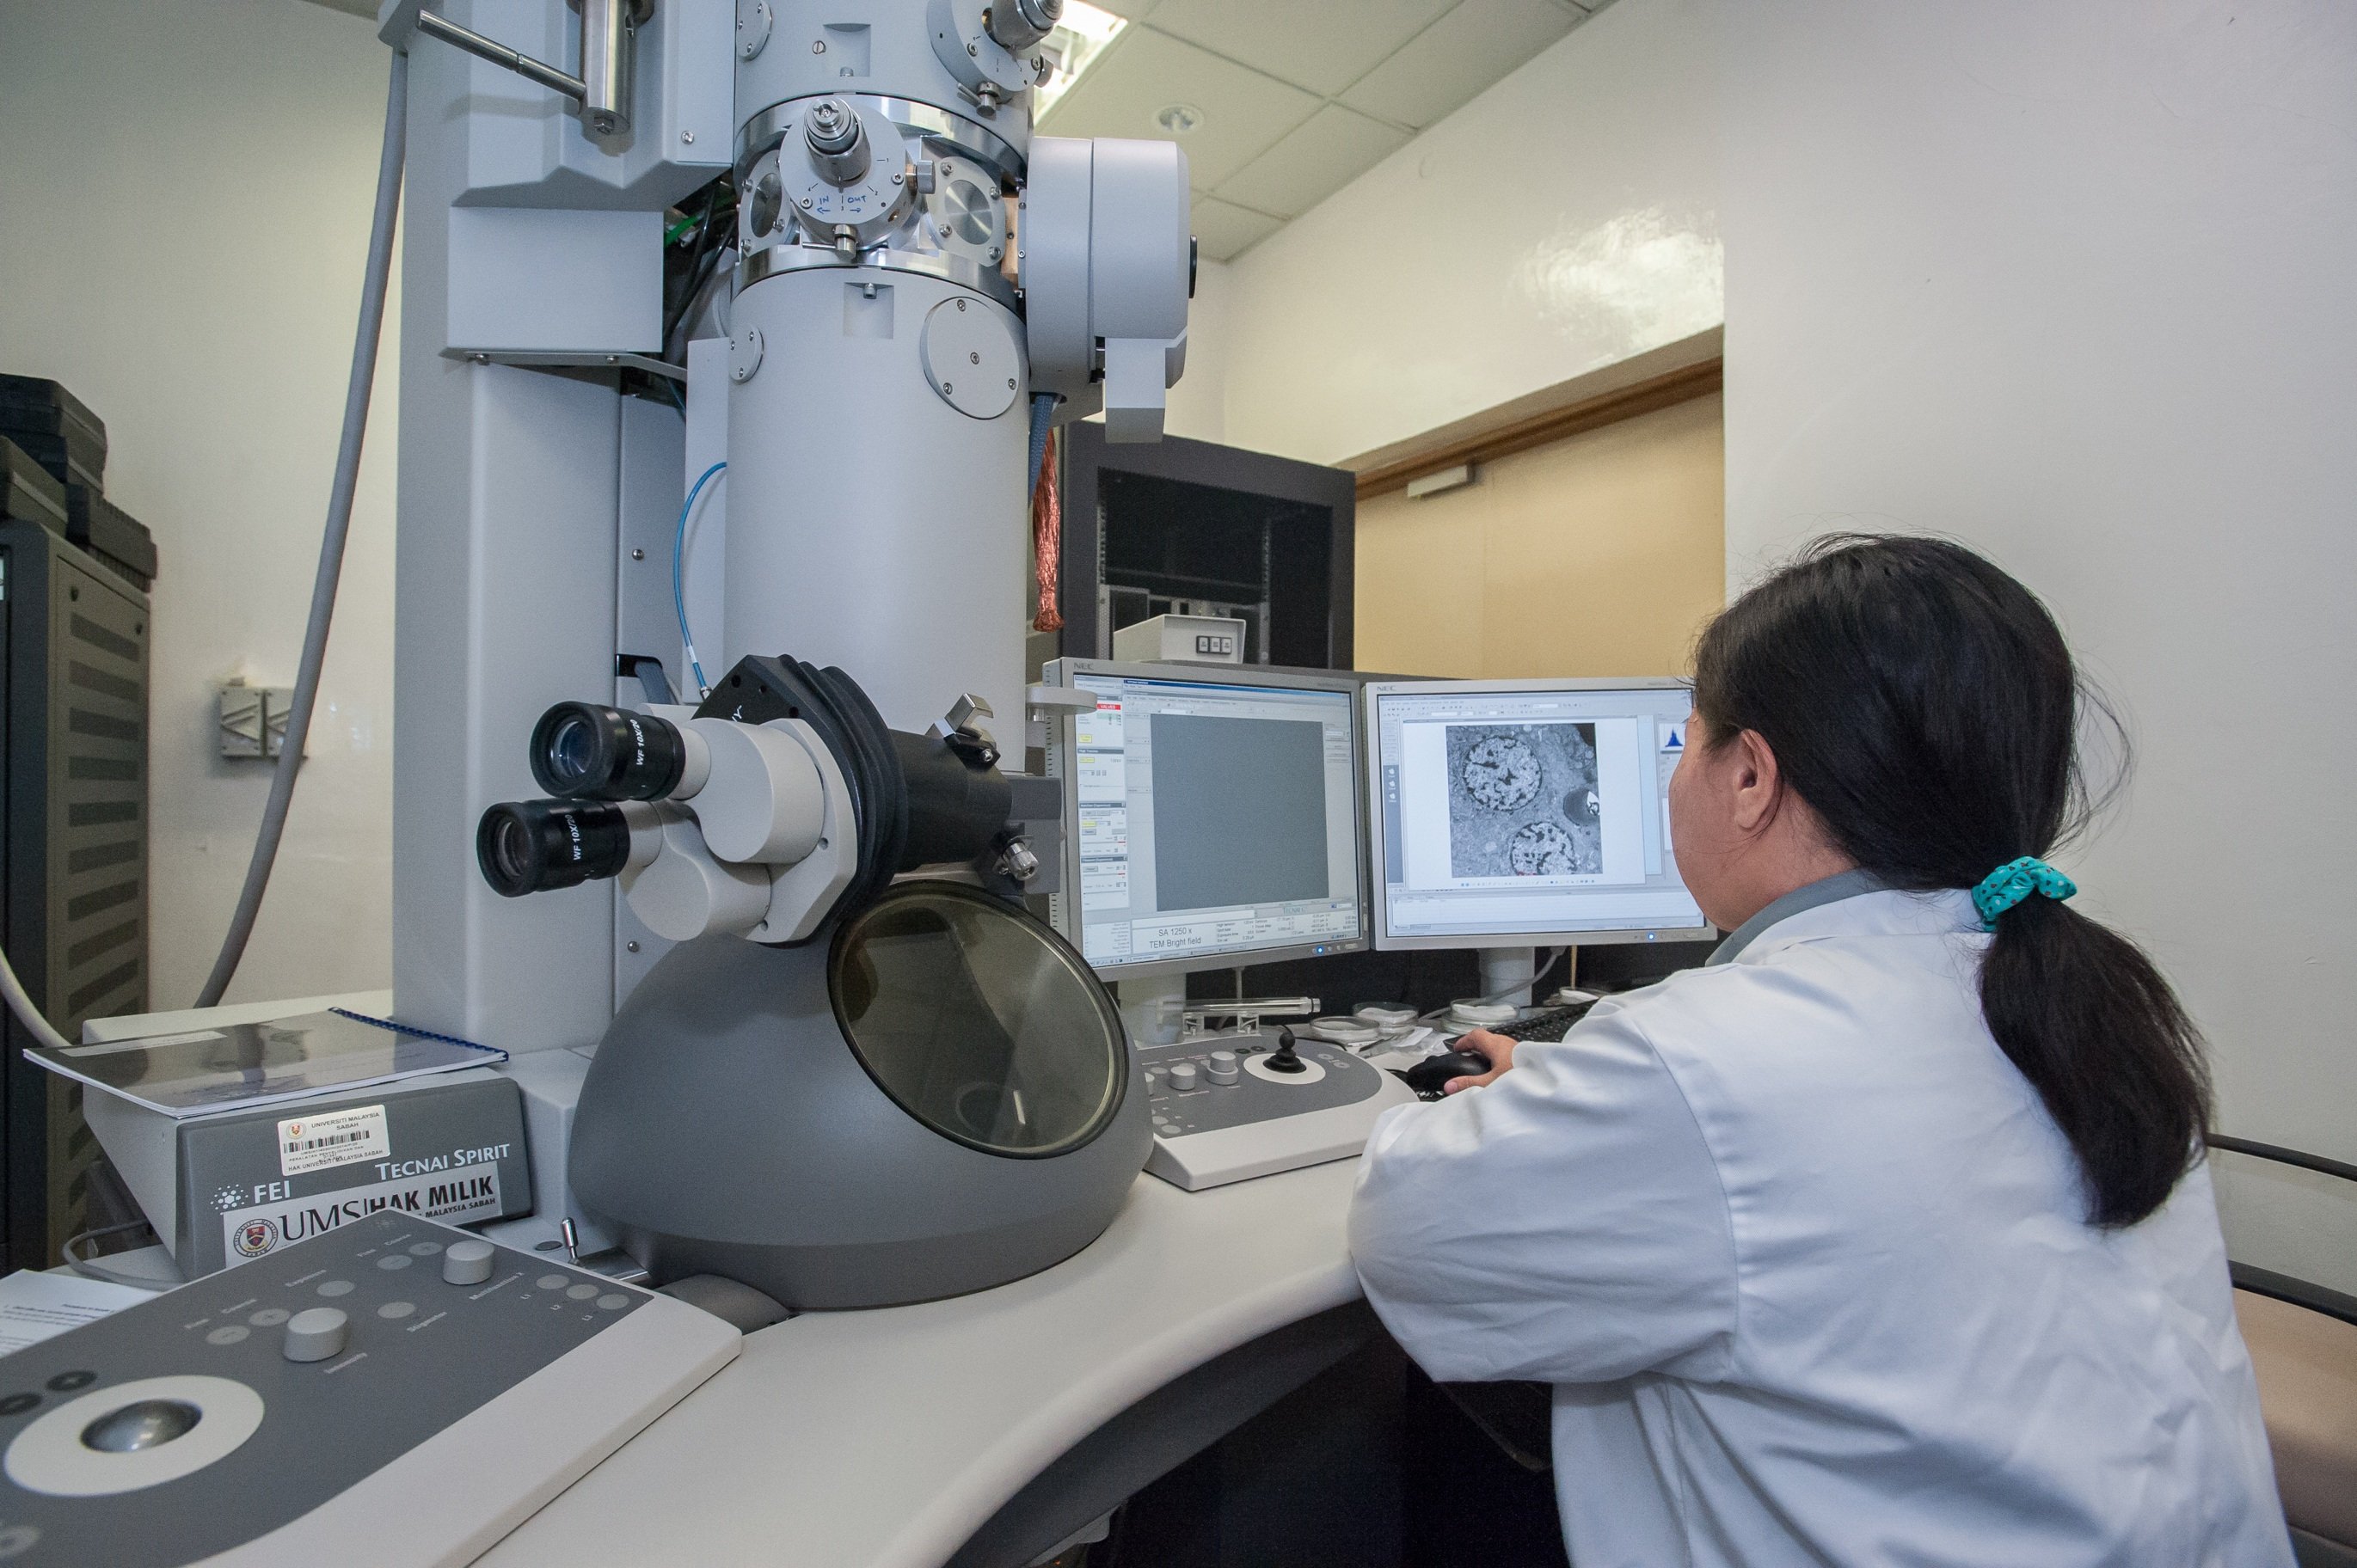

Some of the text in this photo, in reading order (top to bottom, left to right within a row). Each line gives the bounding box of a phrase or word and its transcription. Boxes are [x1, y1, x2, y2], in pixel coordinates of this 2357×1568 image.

[819, 196, 830, 205] IN
[635, 749, 646, 766] WF
[564, 814, 582, 861] WF 10X/20
[1167, 939, 1186, 948] Bright
[311, 1112, 380, 1128] UNIVERSITI MALAYSIA
[336, 1122, 359, 1130] SABAH
[335, 1154, 363, 1162] MALAYSIA
[254, 1181, 291, 1204] FEI
[428, 1175, 494, 1208] MILIK
[425, 1197, 496, 1218] MALAYSIA SABAH
